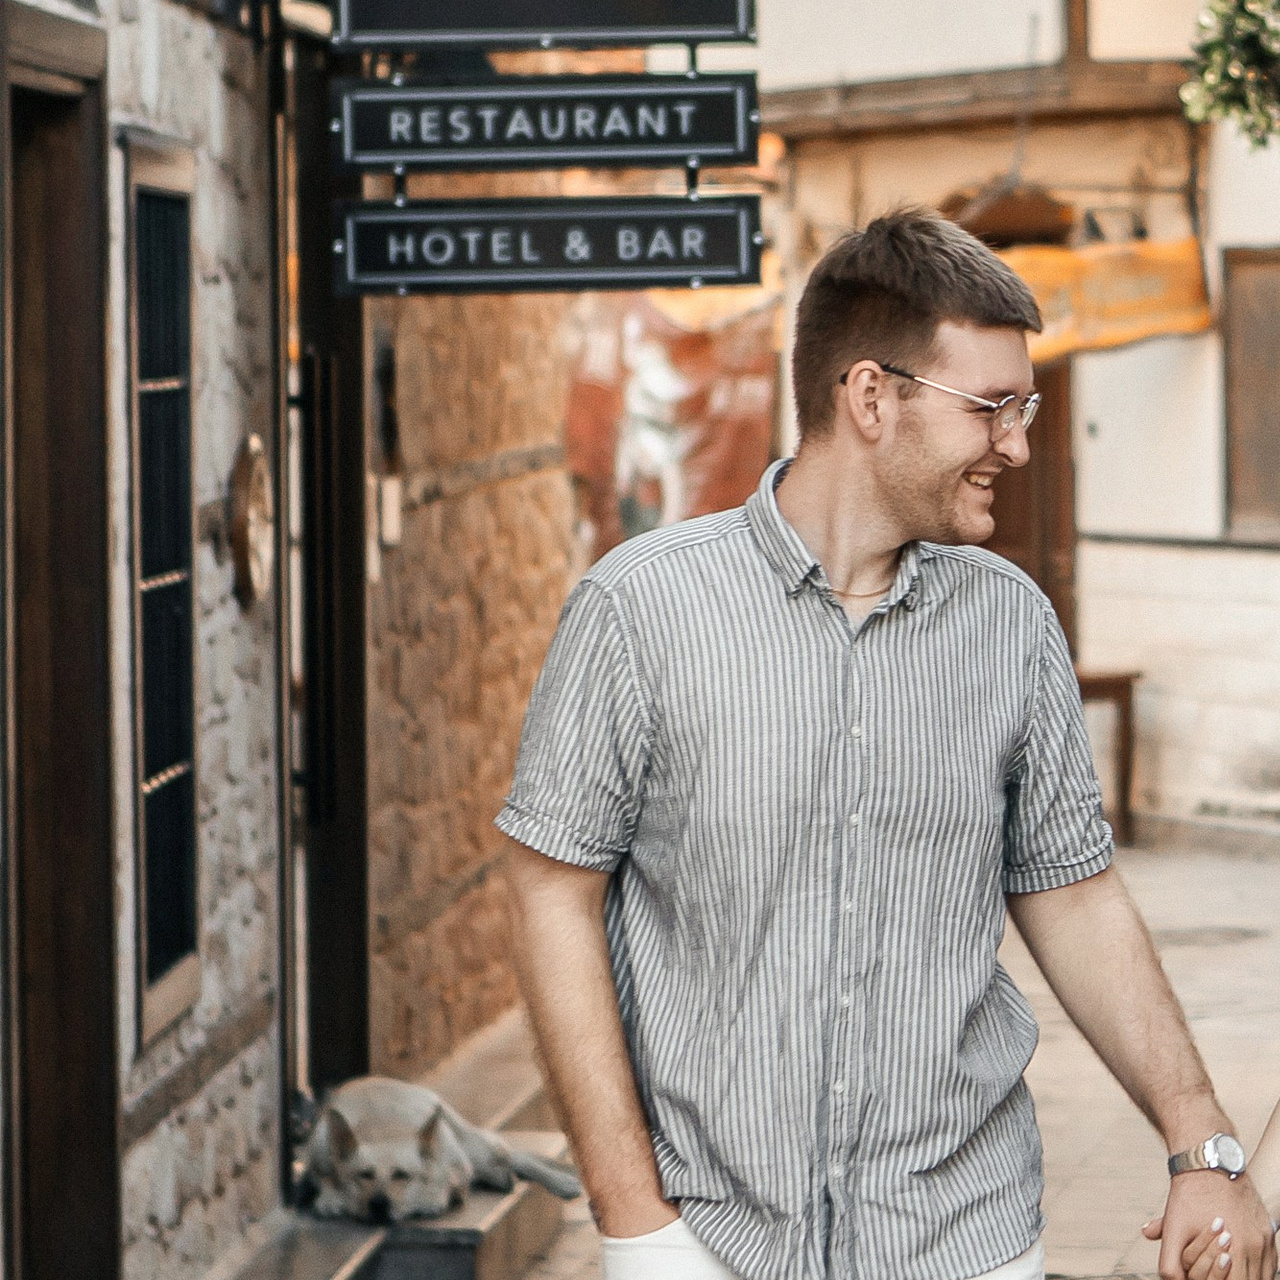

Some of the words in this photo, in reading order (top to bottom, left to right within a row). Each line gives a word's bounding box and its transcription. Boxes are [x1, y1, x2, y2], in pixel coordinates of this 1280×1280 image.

[389, 103, 697, 144] RESTAURANT
[387, 229, 541, 265] HOTEL
[564, 227, 591, 261] &
[617, 225, 706, 261] BAR
